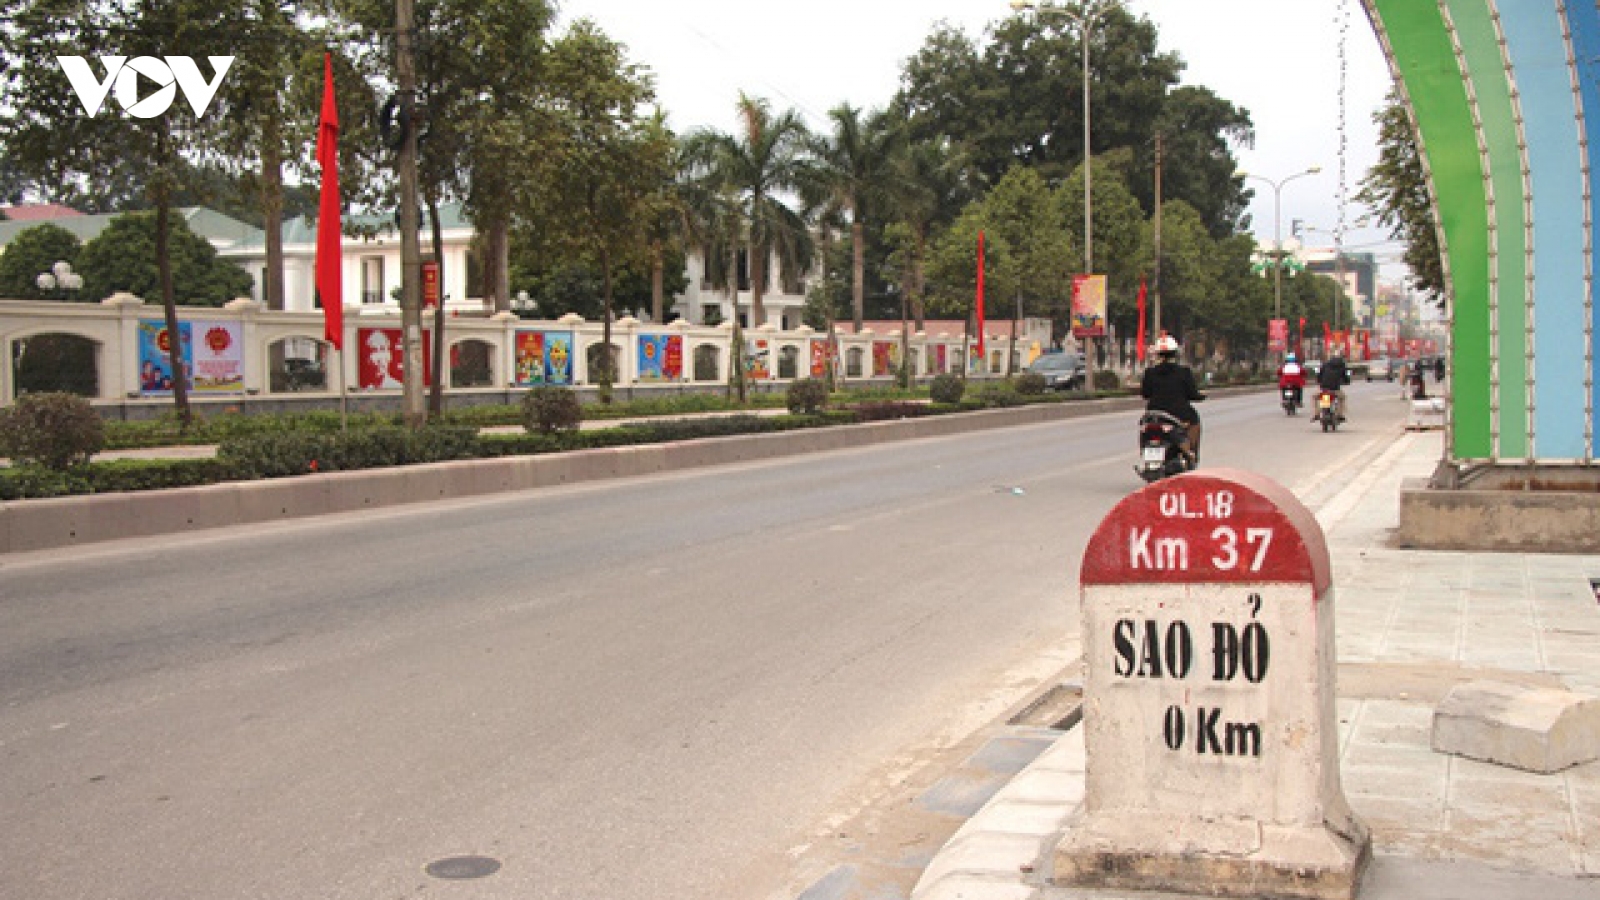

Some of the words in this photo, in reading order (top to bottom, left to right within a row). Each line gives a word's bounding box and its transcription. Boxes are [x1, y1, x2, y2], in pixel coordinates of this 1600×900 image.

[1129, 526, 1189, 570] Km
[1210, 525, 1273, 571] 37
[1113, 618, 1192, 678] SAO
[1164, 705, 1185, 750] 0
[1196, 707, 1261, 756] Km
